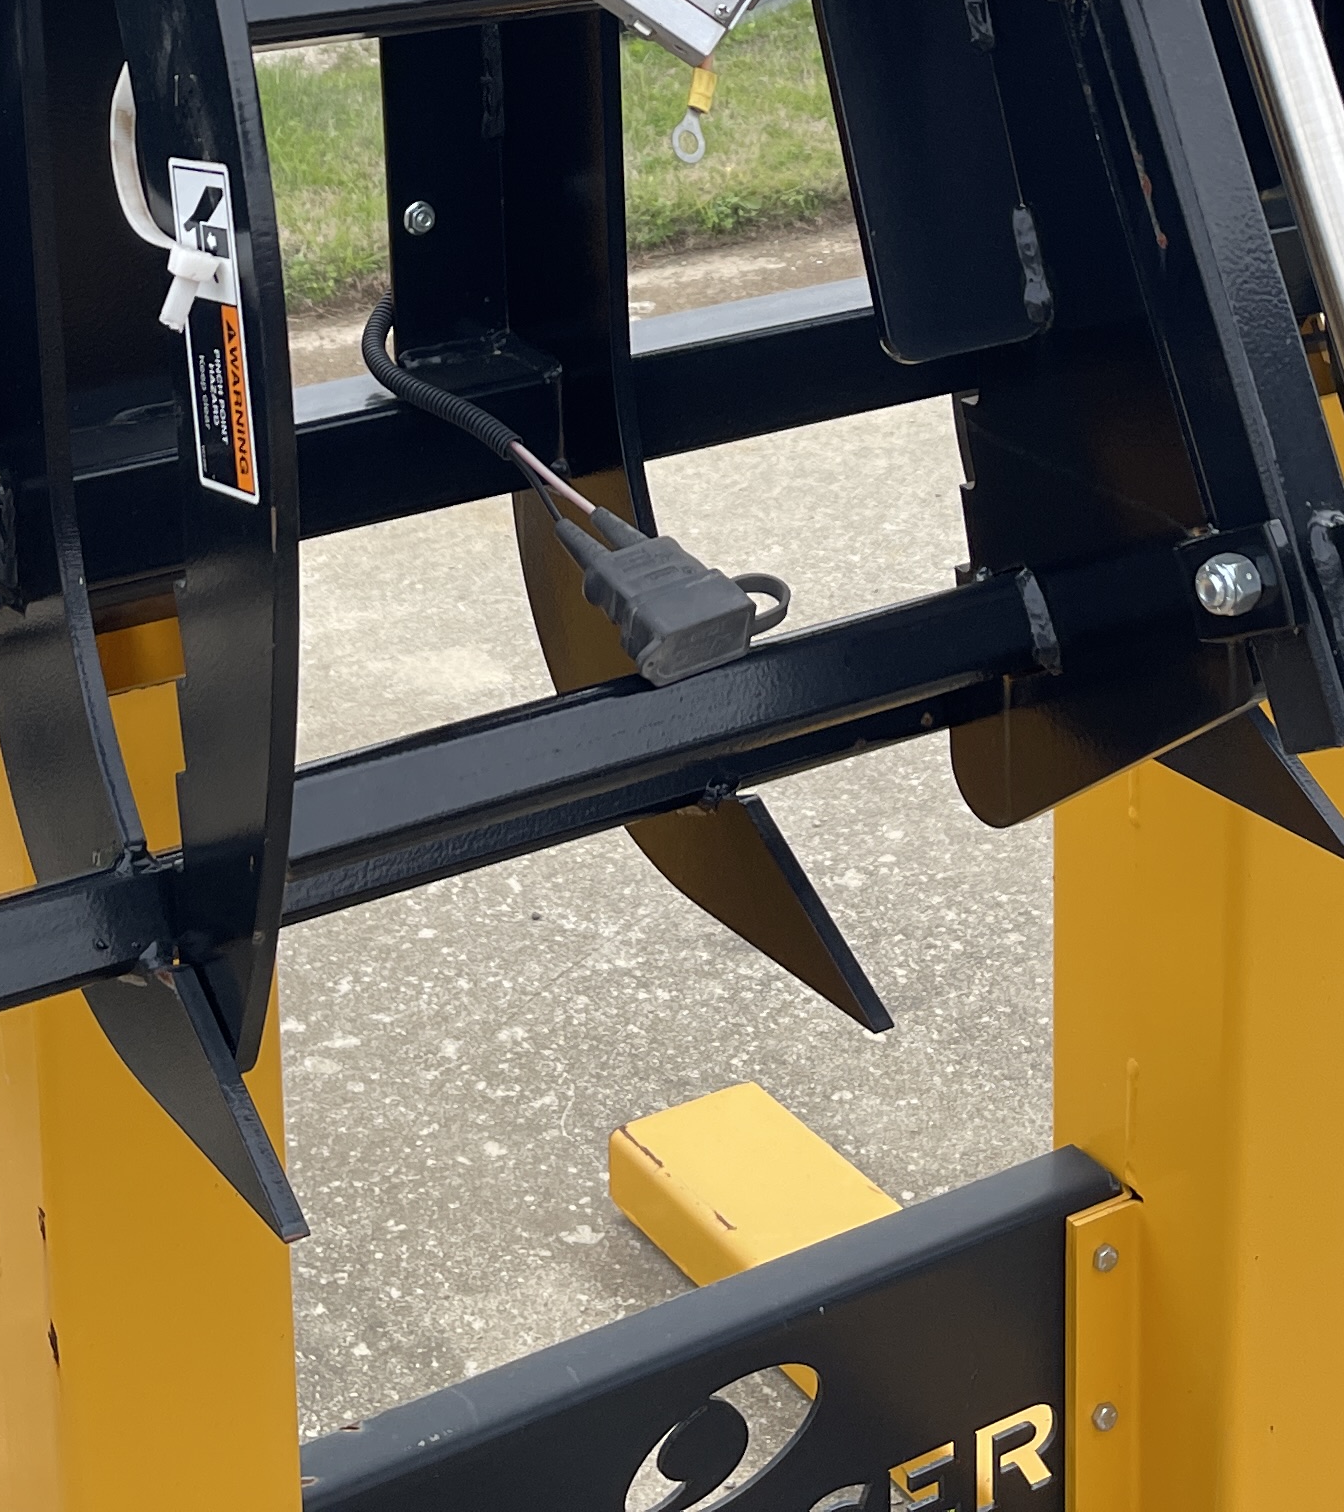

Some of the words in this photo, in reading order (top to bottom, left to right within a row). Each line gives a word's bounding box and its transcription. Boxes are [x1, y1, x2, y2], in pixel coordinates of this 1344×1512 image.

[198, 354, 207, 391] Keep
[208, 363, 220, 426] HAZARD
[213, 348, 224, 396] PINCH
[202, 394, 211, 430] clear
[218, 398, 229, 445] POINT
[229, 346, 249, 475] WARNING
